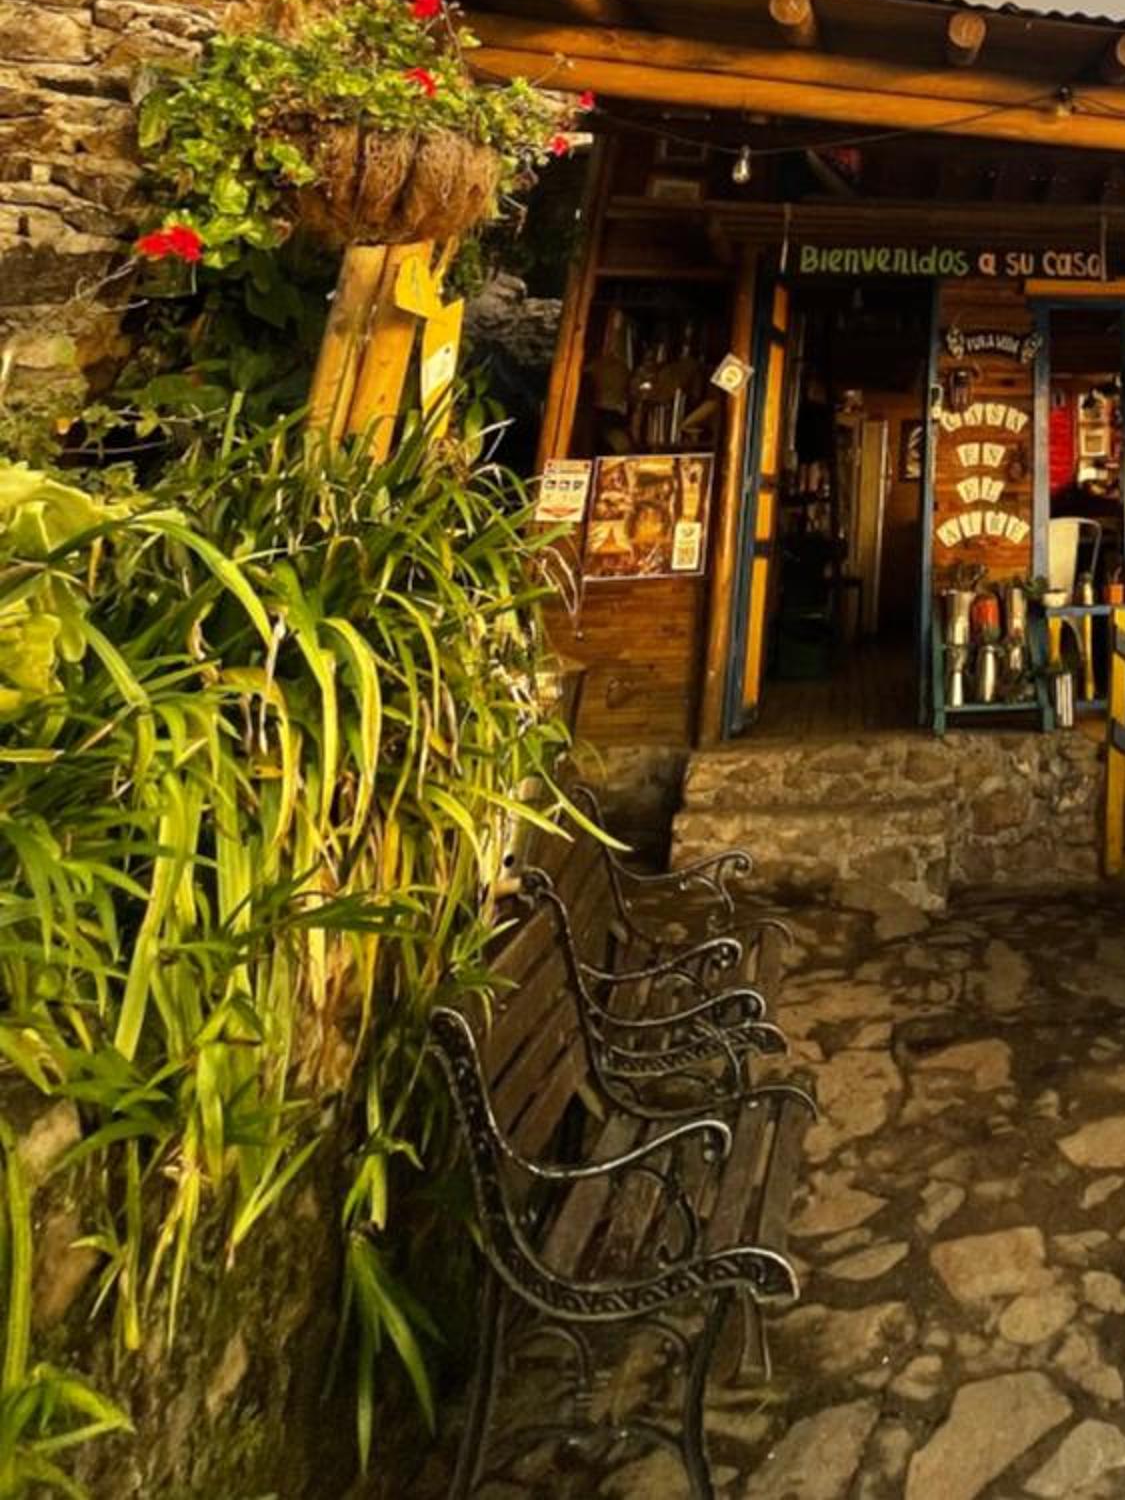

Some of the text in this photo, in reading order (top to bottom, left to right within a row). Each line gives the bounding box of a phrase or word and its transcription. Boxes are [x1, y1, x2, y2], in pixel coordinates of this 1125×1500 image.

[800, 246, 1101, 277] Bienvenidos a su casa
